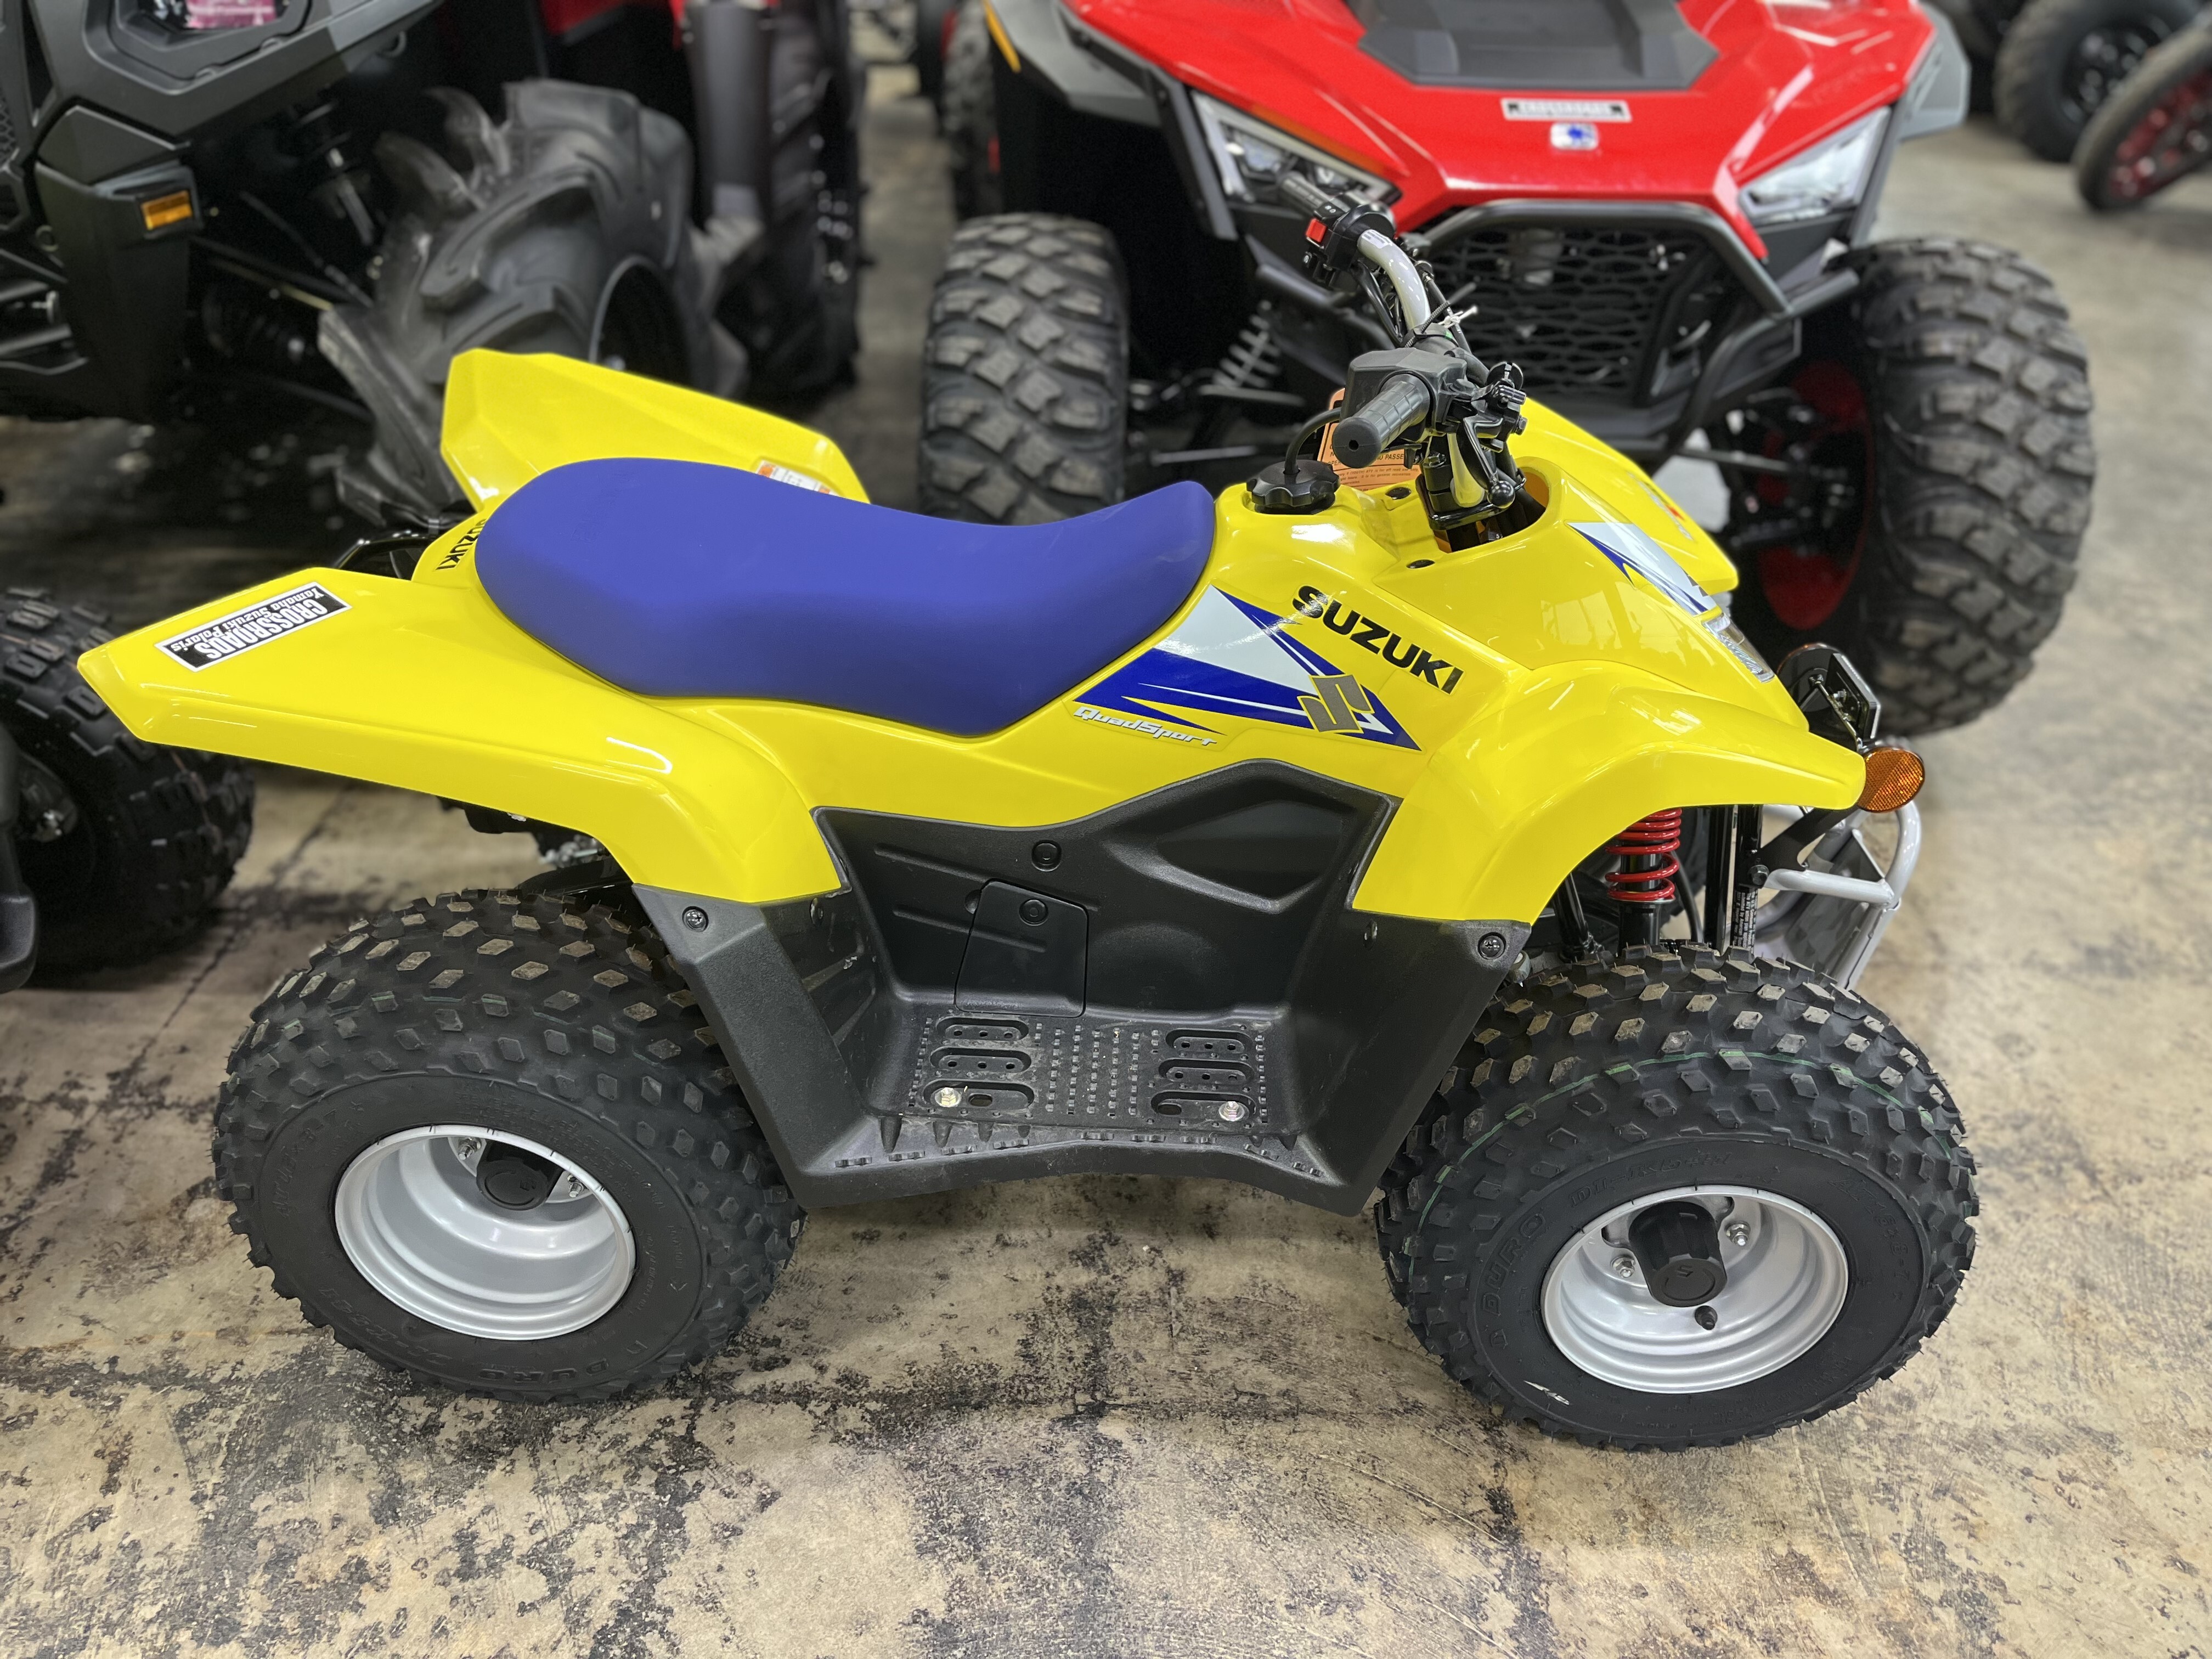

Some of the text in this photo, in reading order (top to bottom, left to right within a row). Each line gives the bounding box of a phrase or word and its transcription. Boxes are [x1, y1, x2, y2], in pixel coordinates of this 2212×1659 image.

[170, 588, 324, 651] Yamaha Suzuki Polaris
[194, 599, 328, 659] CROSSROADS
[1292, 585, 1464, 695] SUZUKI
[1074, 706, 1217, 746] QuadSport
[1482, 1213, 1546, 1317] DURO
